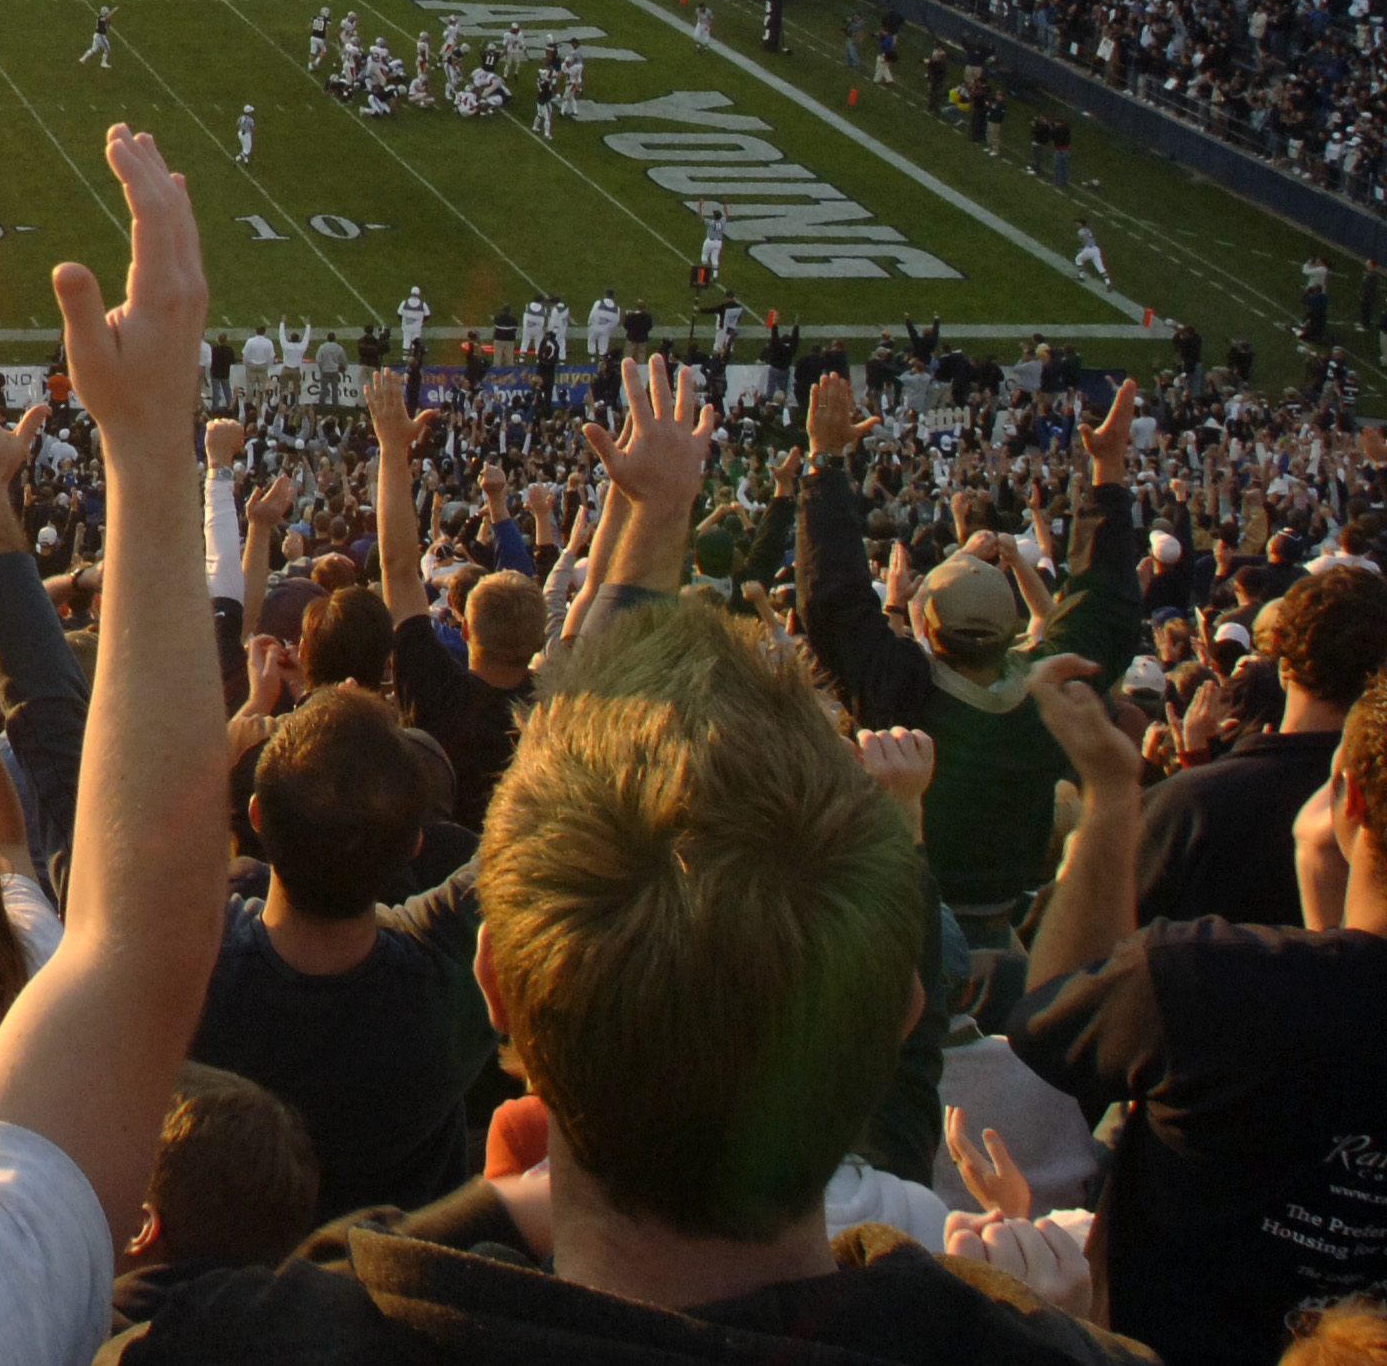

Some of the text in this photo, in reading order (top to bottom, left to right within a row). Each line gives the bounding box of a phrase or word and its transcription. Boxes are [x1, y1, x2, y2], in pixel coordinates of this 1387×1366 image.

[573, 90, 965, 279] YOUNG
[235, 214, 361, 240] 10
[1286, 1203, 1323, 1227] The
[1261, 1216, 1349, 1261] Housing
